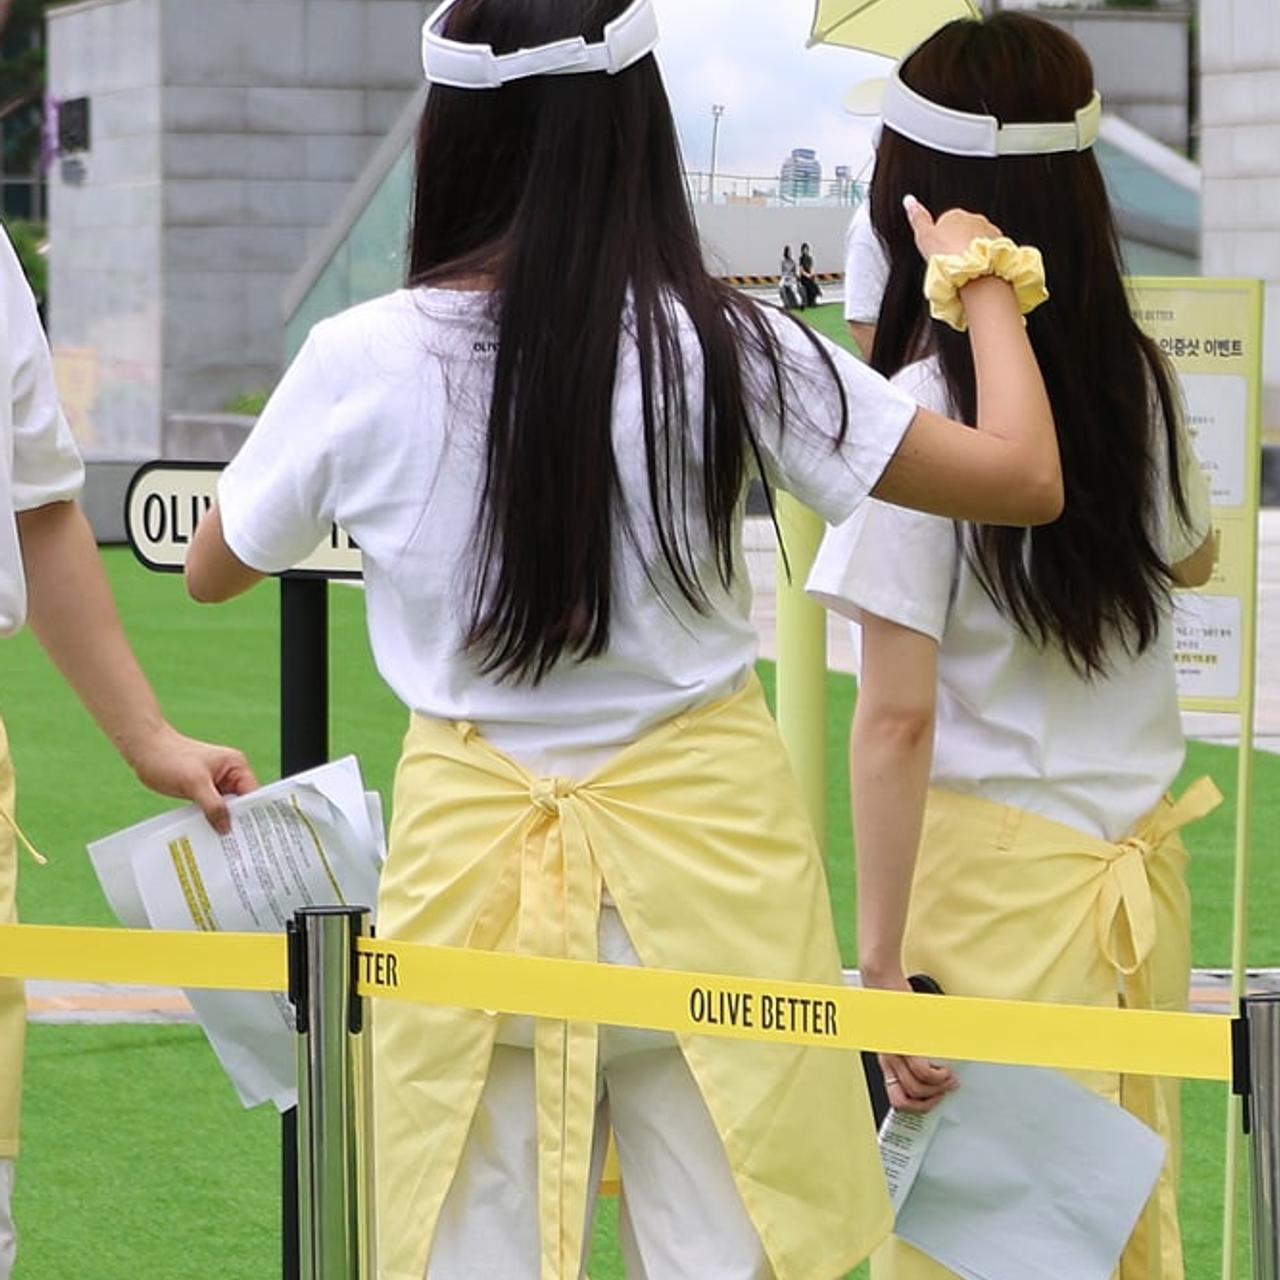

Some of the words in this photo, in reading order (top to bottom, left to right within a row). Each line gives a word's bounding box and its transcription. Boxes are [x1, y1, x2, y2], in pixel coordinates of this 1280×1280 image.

[1203, 337, 1243, 358] 이벤트
[143, 493, 210, 544] OLI
[355, 951, 398, 987] TTER
[690, 988, 753, 1028] OLIVE
[761, 995, 838, 1036] BETTER
